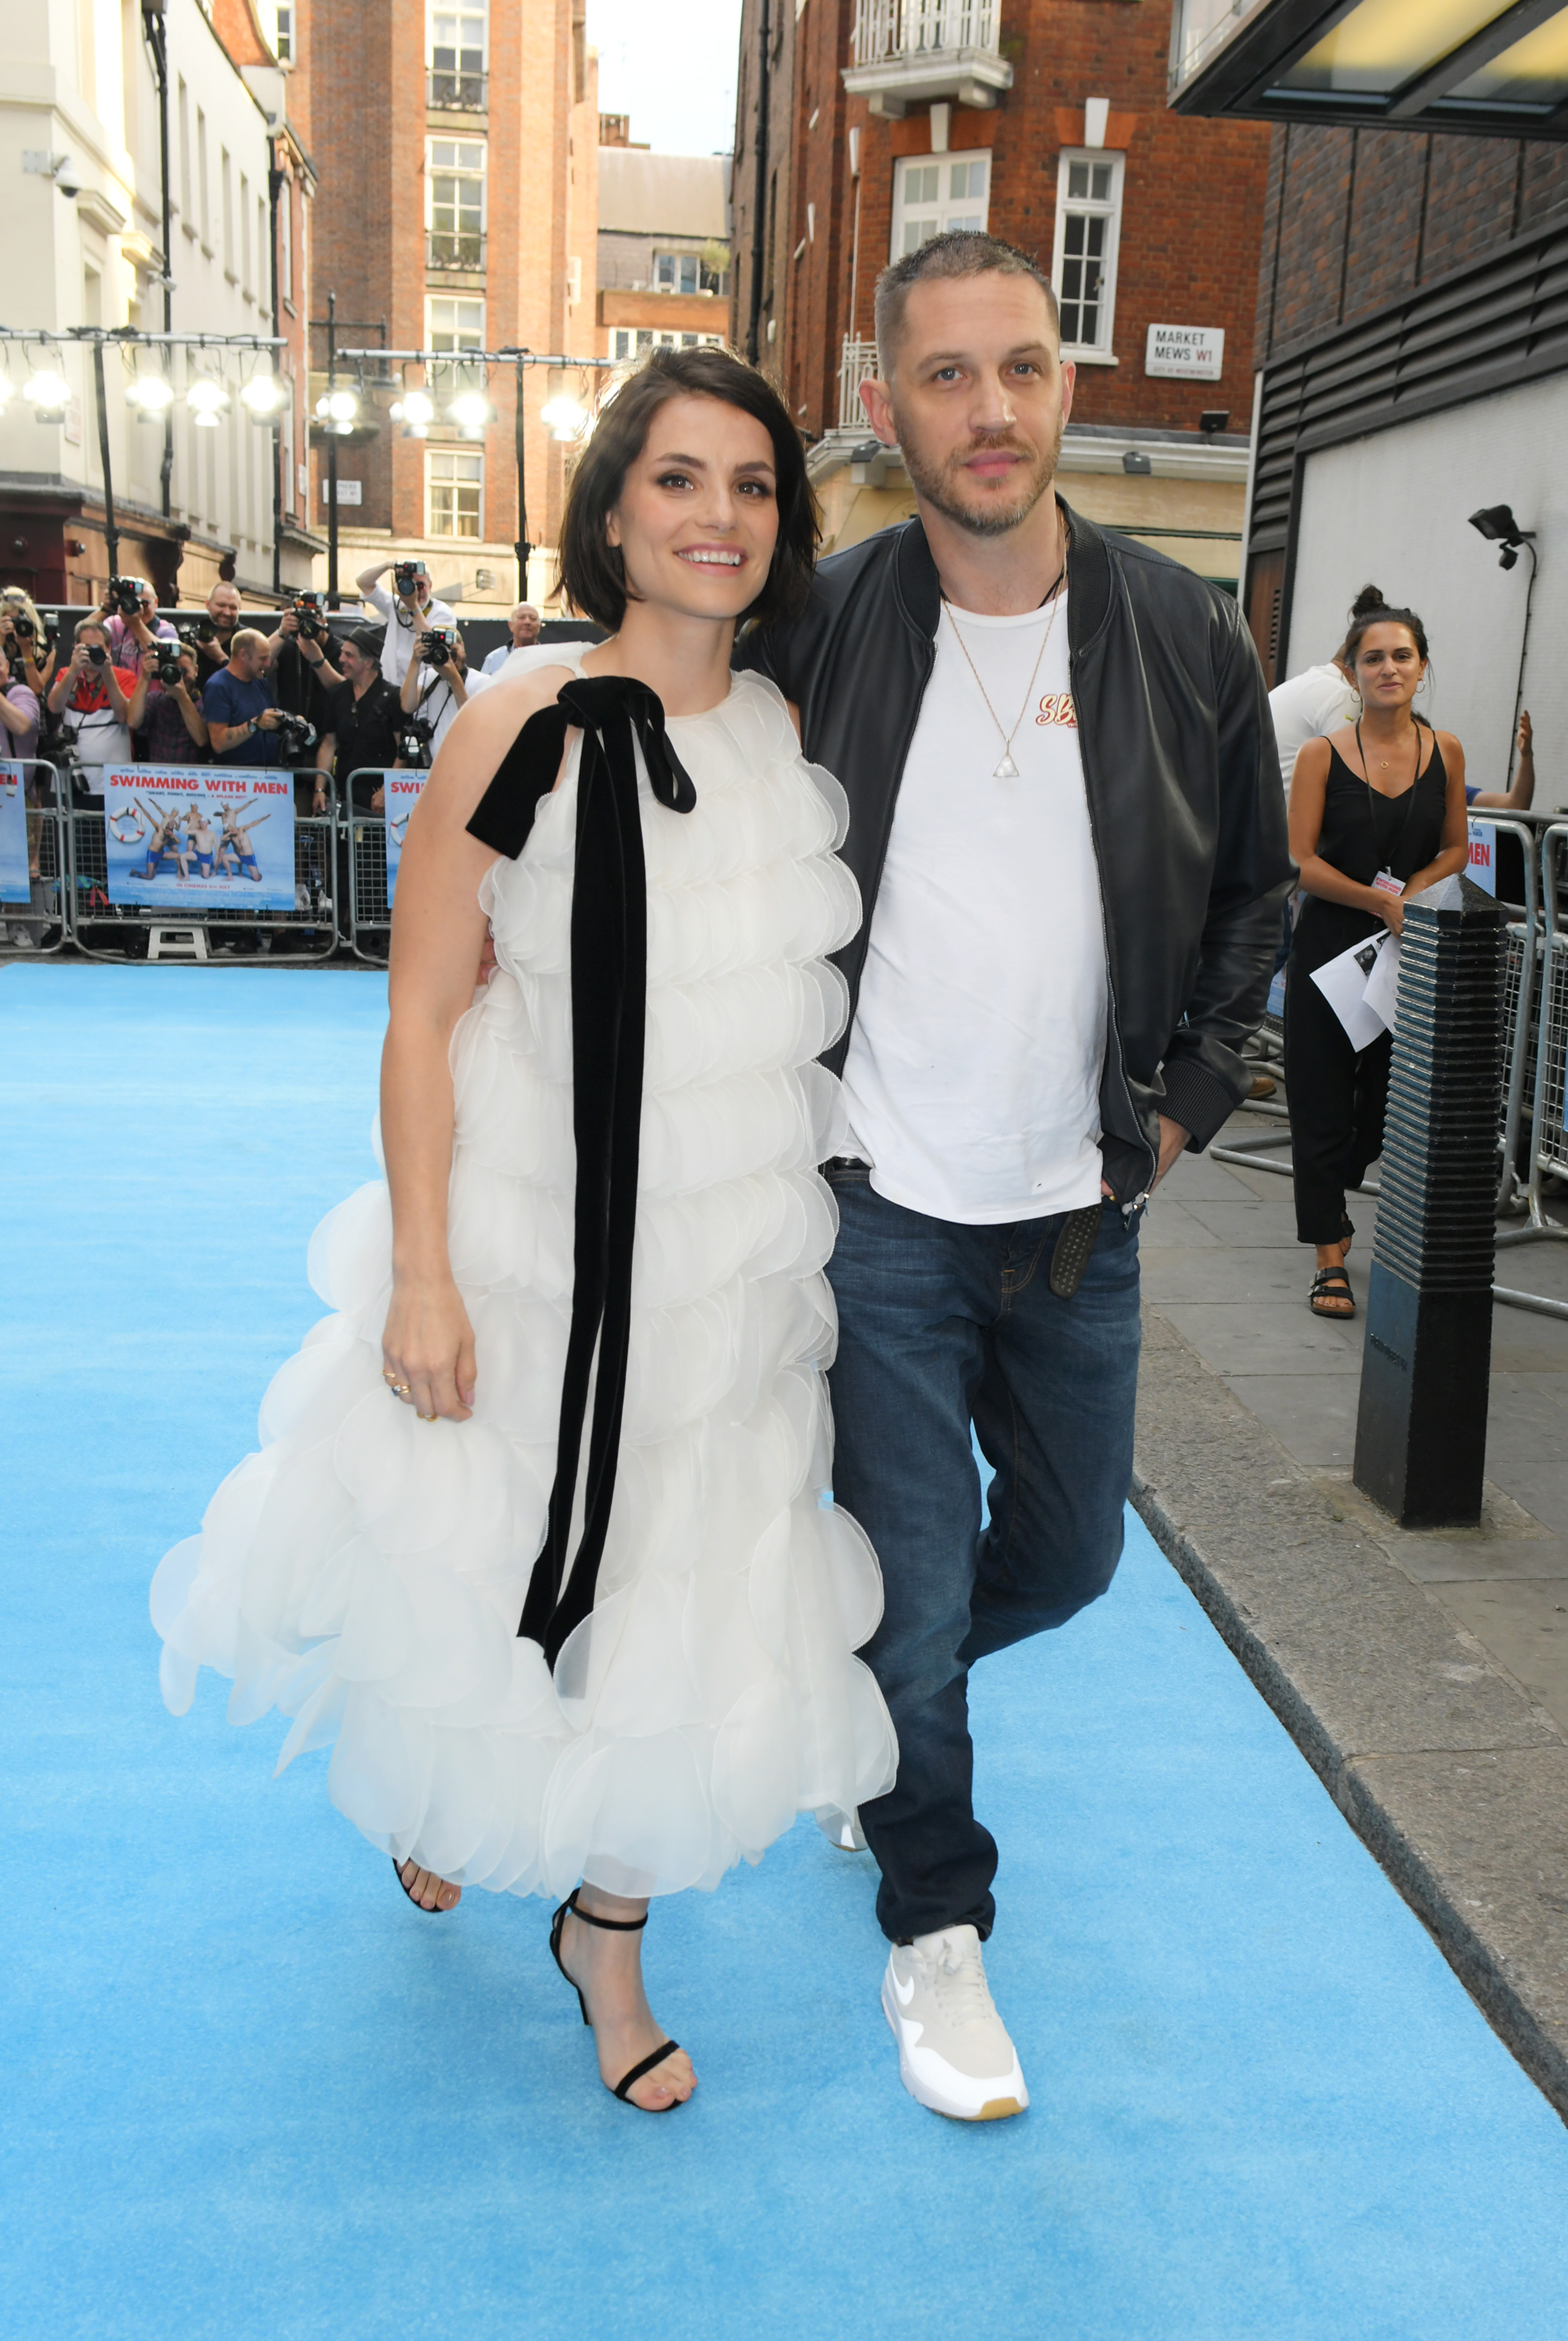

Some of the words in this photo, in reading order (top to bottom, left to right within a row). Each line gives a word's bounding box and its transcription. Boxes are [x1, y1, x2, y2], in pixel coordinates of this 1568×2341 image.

[1156, 330, 1206, 346] MARKET
[1155, 346, 1191, 361] MEWS
[1196, 350, 1212, 362] W1
[1036, 693, 1077, 725] SB
[110, 774, 199, 790] SWIMMING
[205, 780, 246, 793] WITH
[253, 782, 287, 795] MEN
[391, 782, 424, 794] SWI
[1376, 881, 1388, 890] WITH
[1377, 876, 1401, 891] SWIMMING
